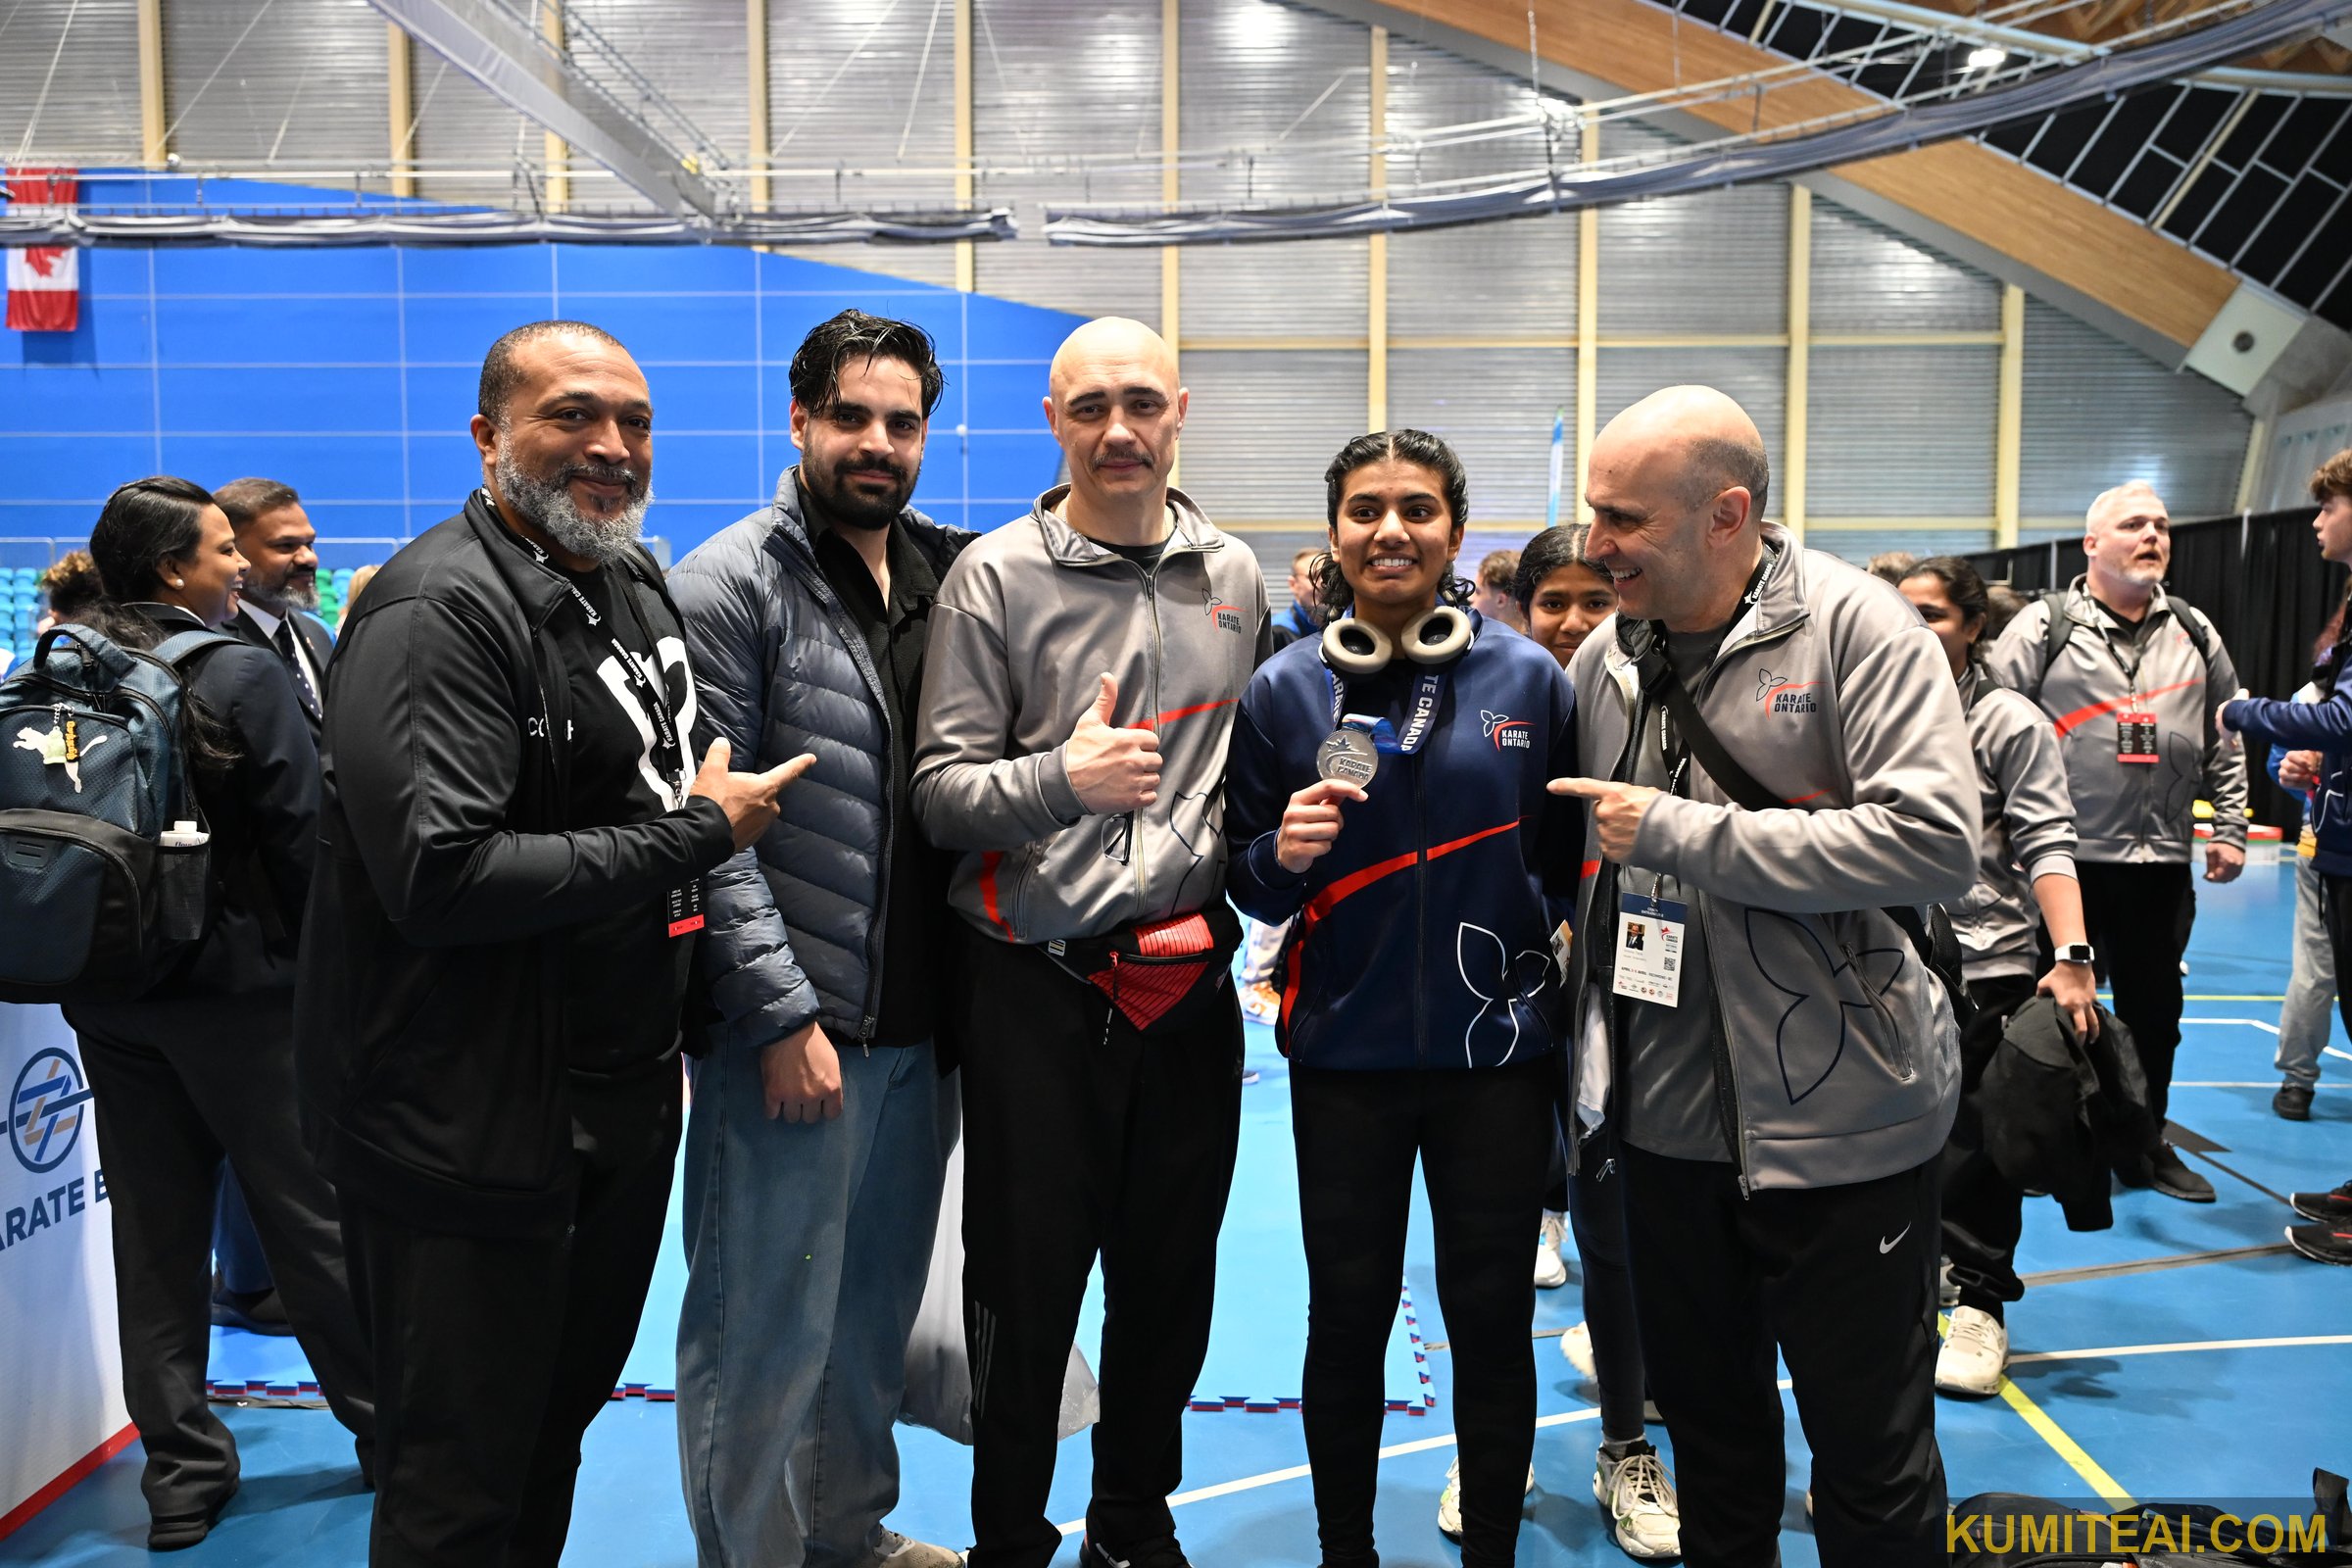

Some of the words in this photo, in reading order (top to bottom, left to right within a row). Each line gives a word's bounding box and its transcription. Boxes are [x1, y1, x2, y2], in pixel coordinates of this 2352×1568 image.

[1751, 579, 1766, 600] KARATE
[578, 596, 598, 617] KARATE
[1217, 612, 1240, 625] KARATE
[1218, 619, 1242, 634] ONTARIO
[612, 638, 629, 661] CANADA
[627, 658, 643, 679] KARATE
[1775, 692, 1812, 705] KARATE
[653, 701, 665, 722] CANADA
[1774, 703, 1817, 714] ONTARIO
[661, 720, 674, 742] KARATE
[1501, 729, 1529, 740] KARATE
[1501, 737, 1531, 749] ONTARIO
[1339, 757, 1373, 772] KARATE
[0, 1176, 85, 1251] RATE
